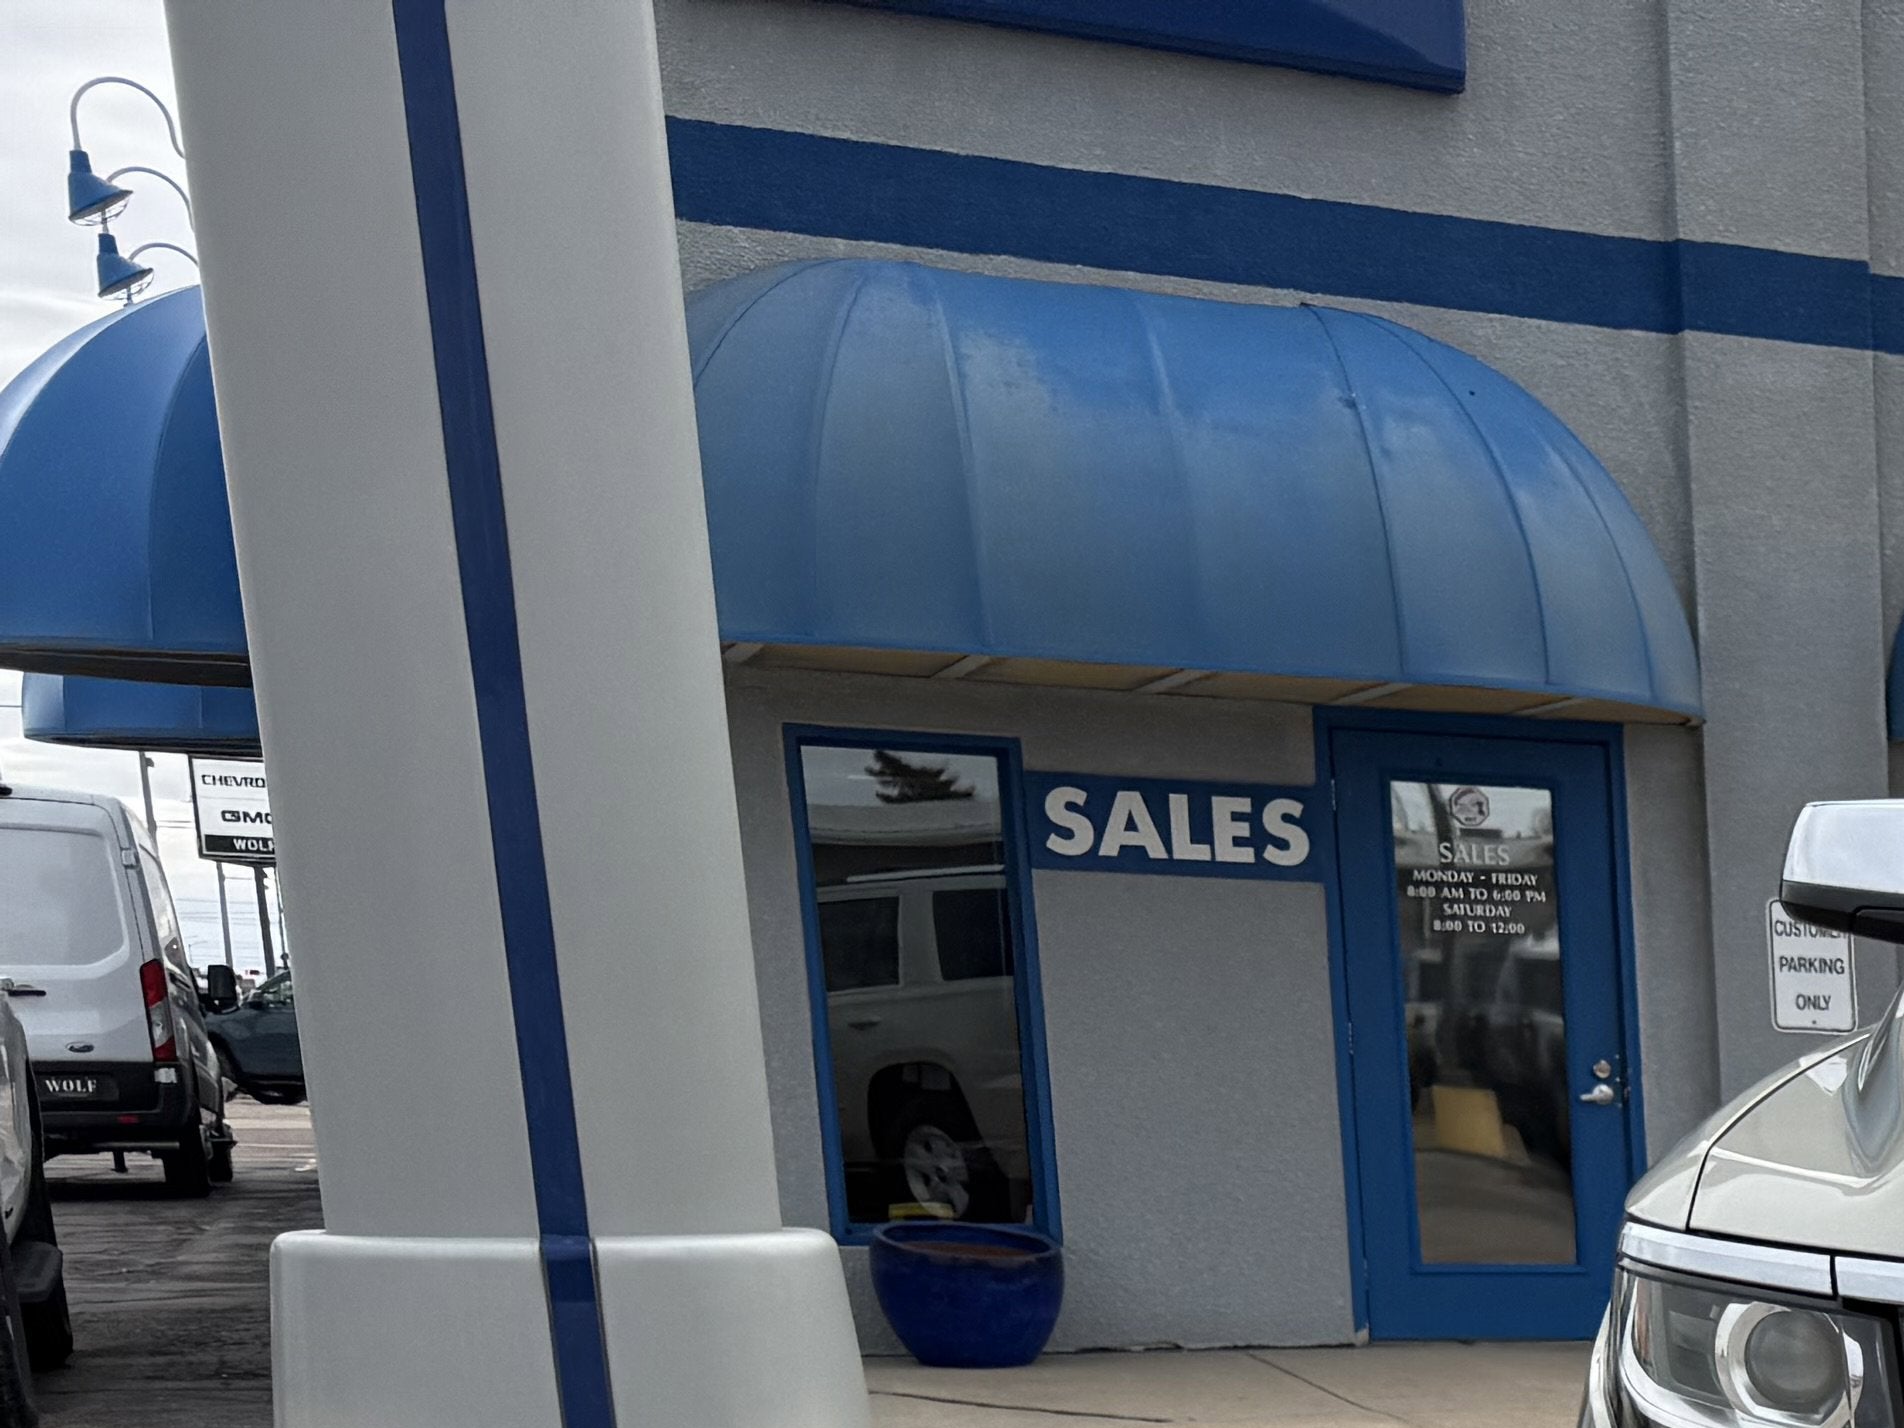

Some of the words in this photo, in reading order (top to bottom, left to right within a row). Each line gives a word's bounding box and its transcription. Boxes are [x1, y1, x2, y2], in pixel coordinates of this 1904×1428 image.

[1045, 786, 1310, 867] SALES
[1439, 842, 1510, 866] SALES
[1412, 869, 1474, 883] MONDAY
[1491, 873, 1537, 886] FRIDAY
[1407, 885, 1436, 898] 8:00
[1441, 887, 1463, 899] AM
[1469, 888, 1488, 900] TO
[1493, 889, 1521, 902] 6:00
[1525, 891, 1546, 903] PM
[1442, 903, 1511, 917] SATURDAY
[1433, 919, 1462, 932] 8:00
[1467, 921, 1486, 932] TO
[1492, 922, 1525, 934] 12:00
[1779, 956, 1845, 975] PARKING
[1795, 993, 1831, 1011] ONLY
[45, 1079, 97, 1093] WOLF
